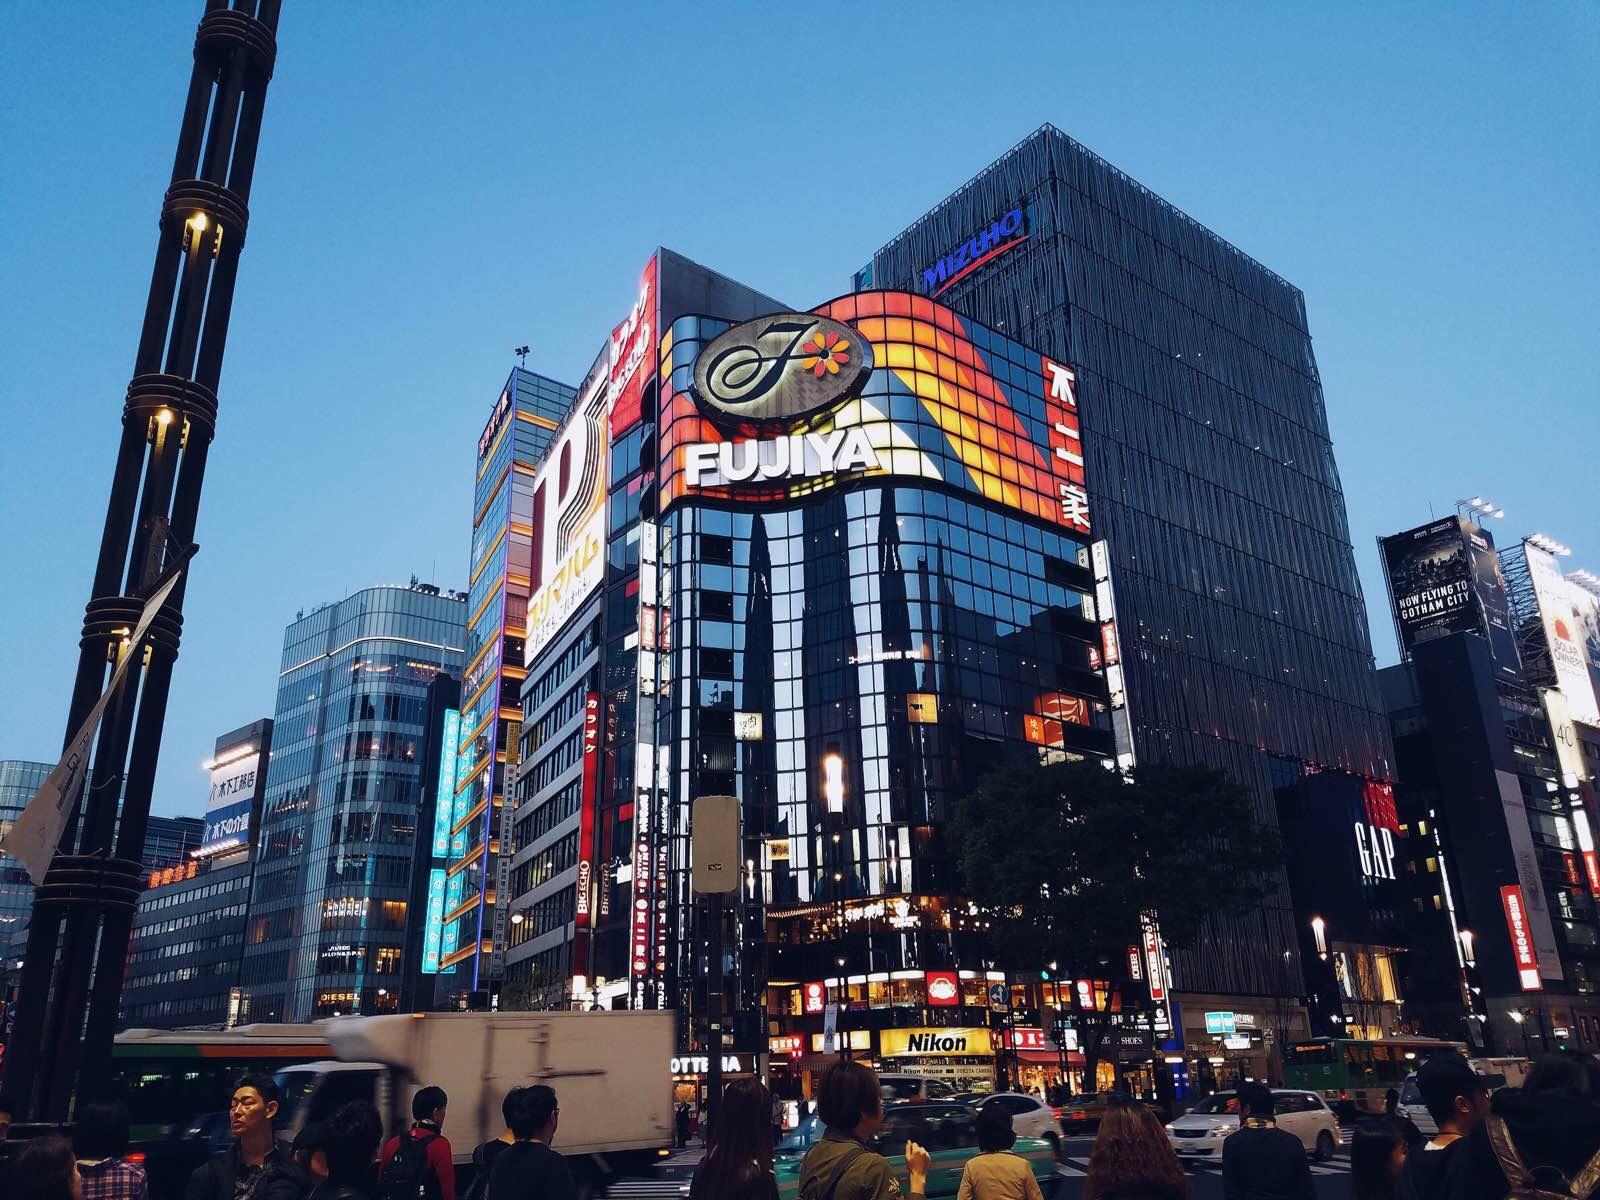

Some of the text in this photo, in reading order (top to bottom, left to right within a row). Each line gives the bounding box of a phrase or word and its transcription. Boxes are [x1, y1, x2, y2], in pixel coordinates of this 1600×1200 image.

[923, 208, 1023, 290] MIZUHO
[686, 427, 881, 486] FUJIYA
[1047, 361, 1090, 528] 不二家
[1399, 580, 1468, 609] NOW FLYING TO
[1402, 598, 1444, 620] GOTHAM
[1447, 592, 1469, 607] CITY
[585, 699, 597, 754] カラオケ
[1029, 717, 1040, 741] 焼肉
[1355, 822, 1396, 880] GAP
[635, 912, 647, 956] 不二家
[320, 993, 361, 1001] DIESEL
[908, 1033, 967, 1052] Nikon
[1120, 1036, 1143, 1045] SHOES
